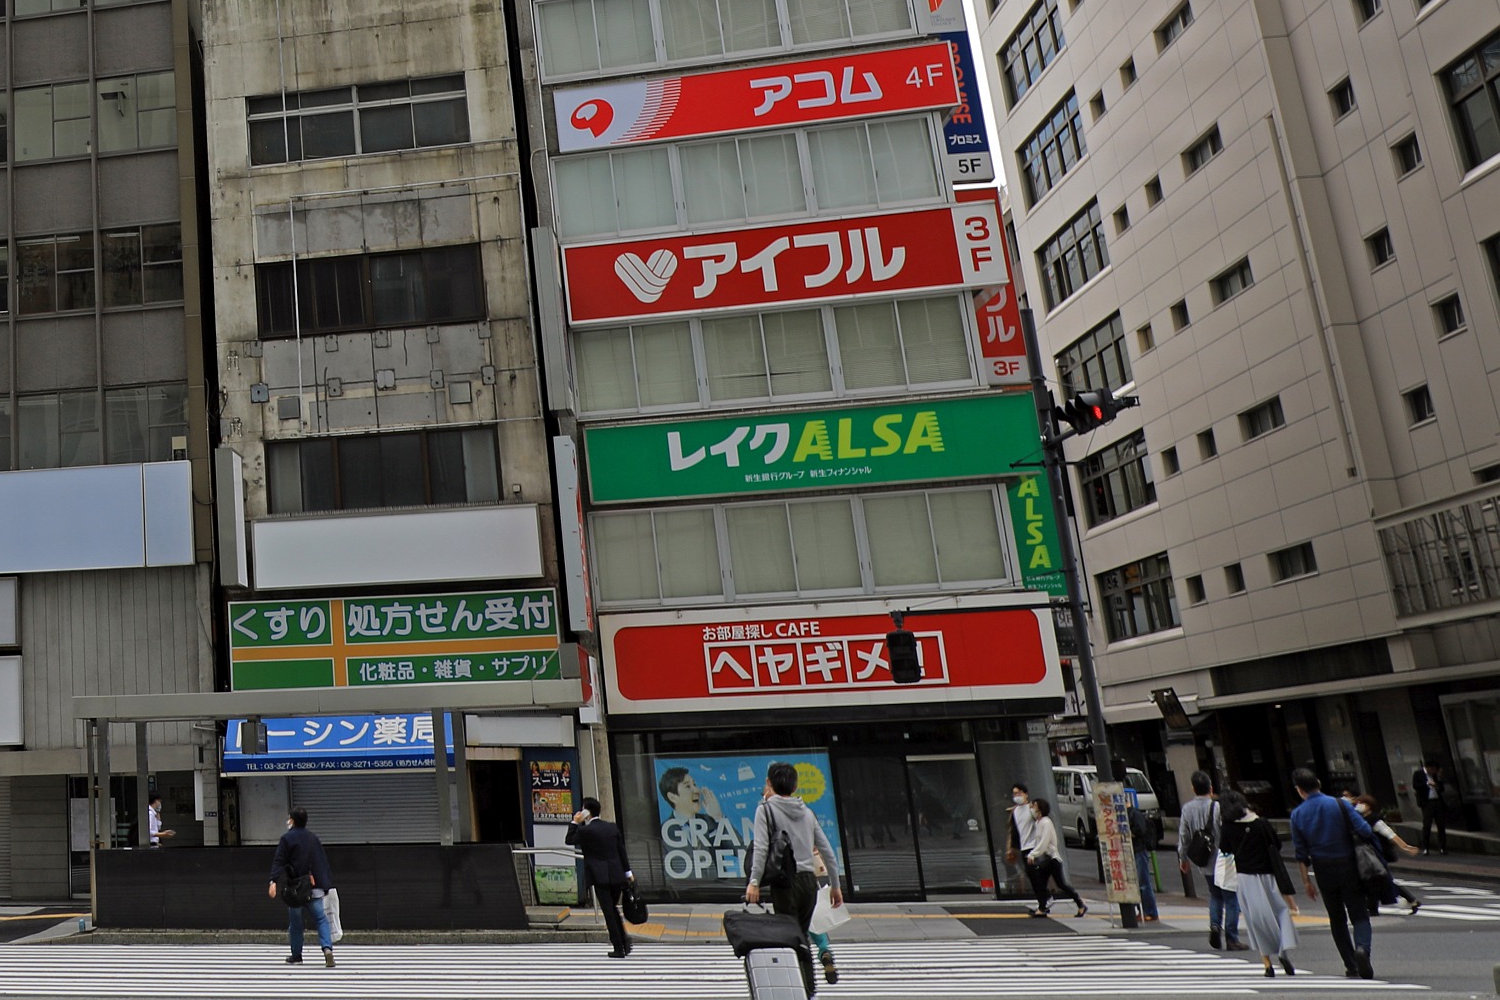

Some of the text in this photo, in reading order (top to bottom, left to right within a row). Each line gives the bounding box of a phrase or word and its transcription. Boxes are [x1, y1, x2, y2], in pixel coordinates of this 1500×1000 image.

[750, 66, 883, 117] アコム
[905, 62, 944, 90] 4F
[948, 133, 983, 146] プロミス
[958, 158, 982, 174] 5F
[964, 216, 994, 272] 3F
[683, 227, 906, 299] アイフル
[993, 361, 1020, 377] 3F
[667, 411, 945, 472] レイクALSA
[744, 466, 873, 484] 新生銀行グループ 新生フィナンシャル
[1017, 476, 1052, 569] ALSA
[233, 596, 554, 640] くすり 処方せん受付
[702, 621, 821, 642] お部屋探し CAFE
[359, 655, 548, 682] 化粧品・雑貨・サプリ
[236, 716, 434, 748] ーシン薬局
[532, 776, 570, 787] スーリヤ
